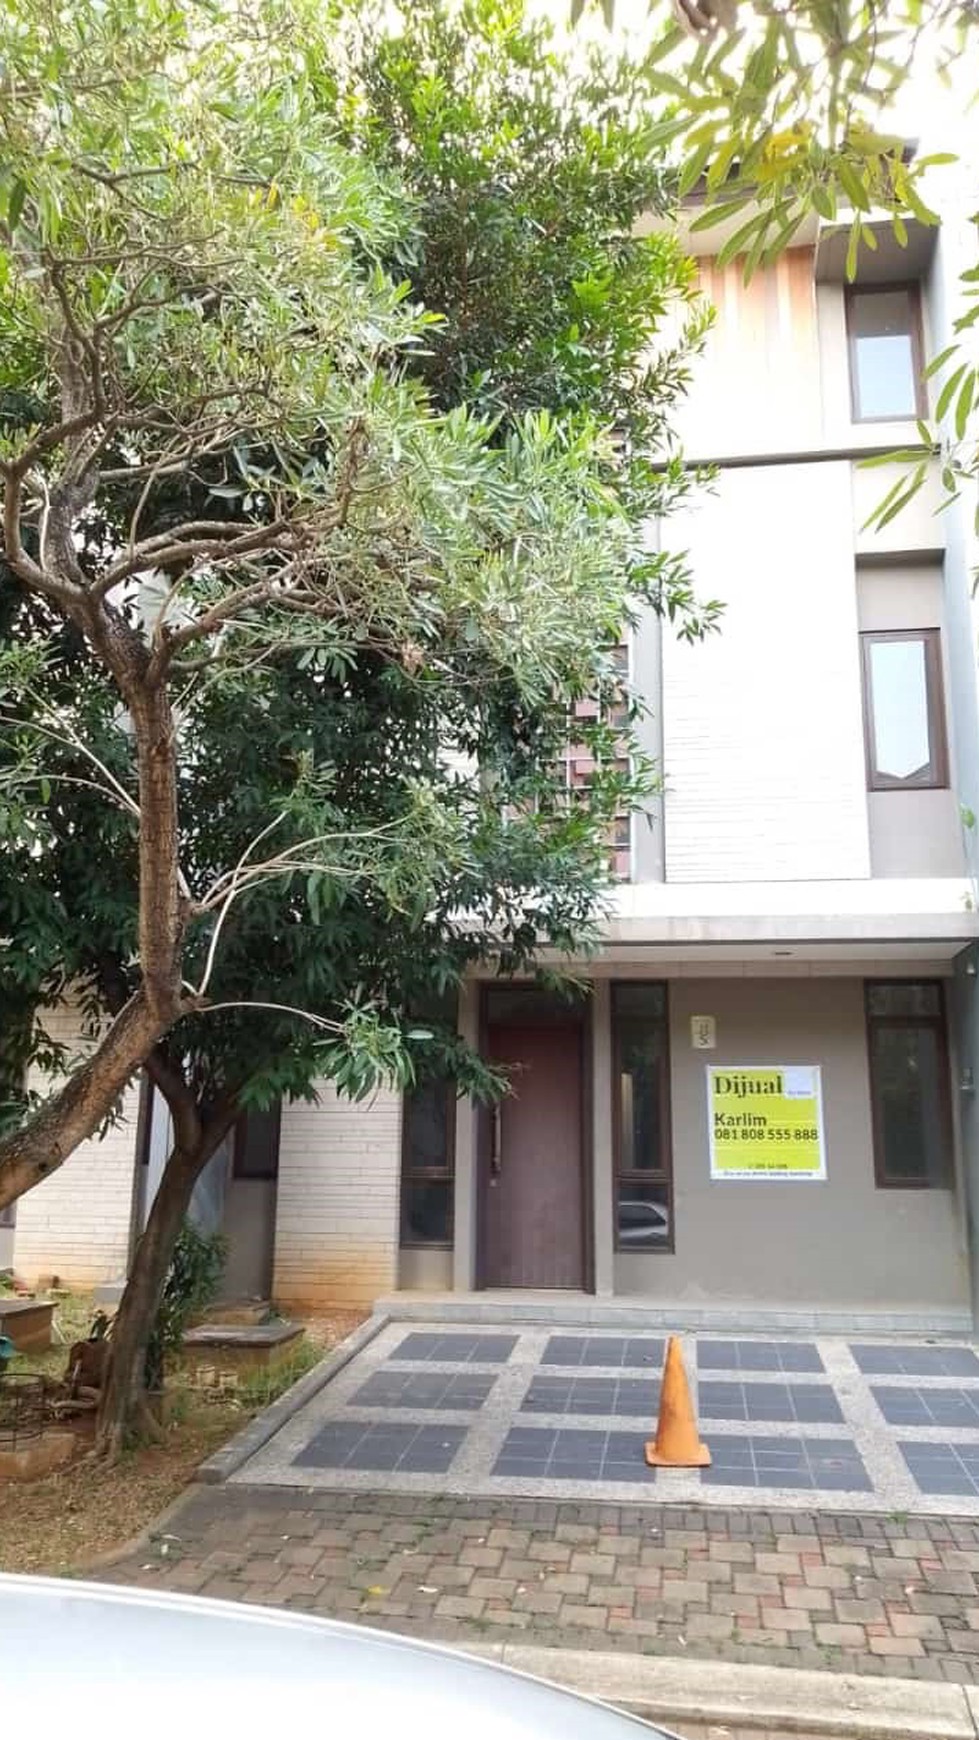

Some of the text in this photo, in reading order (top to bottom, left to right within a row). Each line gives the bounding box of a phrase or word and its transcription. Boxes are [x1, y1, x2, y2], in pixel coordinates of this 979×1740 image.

[714, 1075, 783, 1098] Dijual
[714, 1112, 767, 1126] Karlim
[714, 1128, 818, 1140] 081 808 555 888
